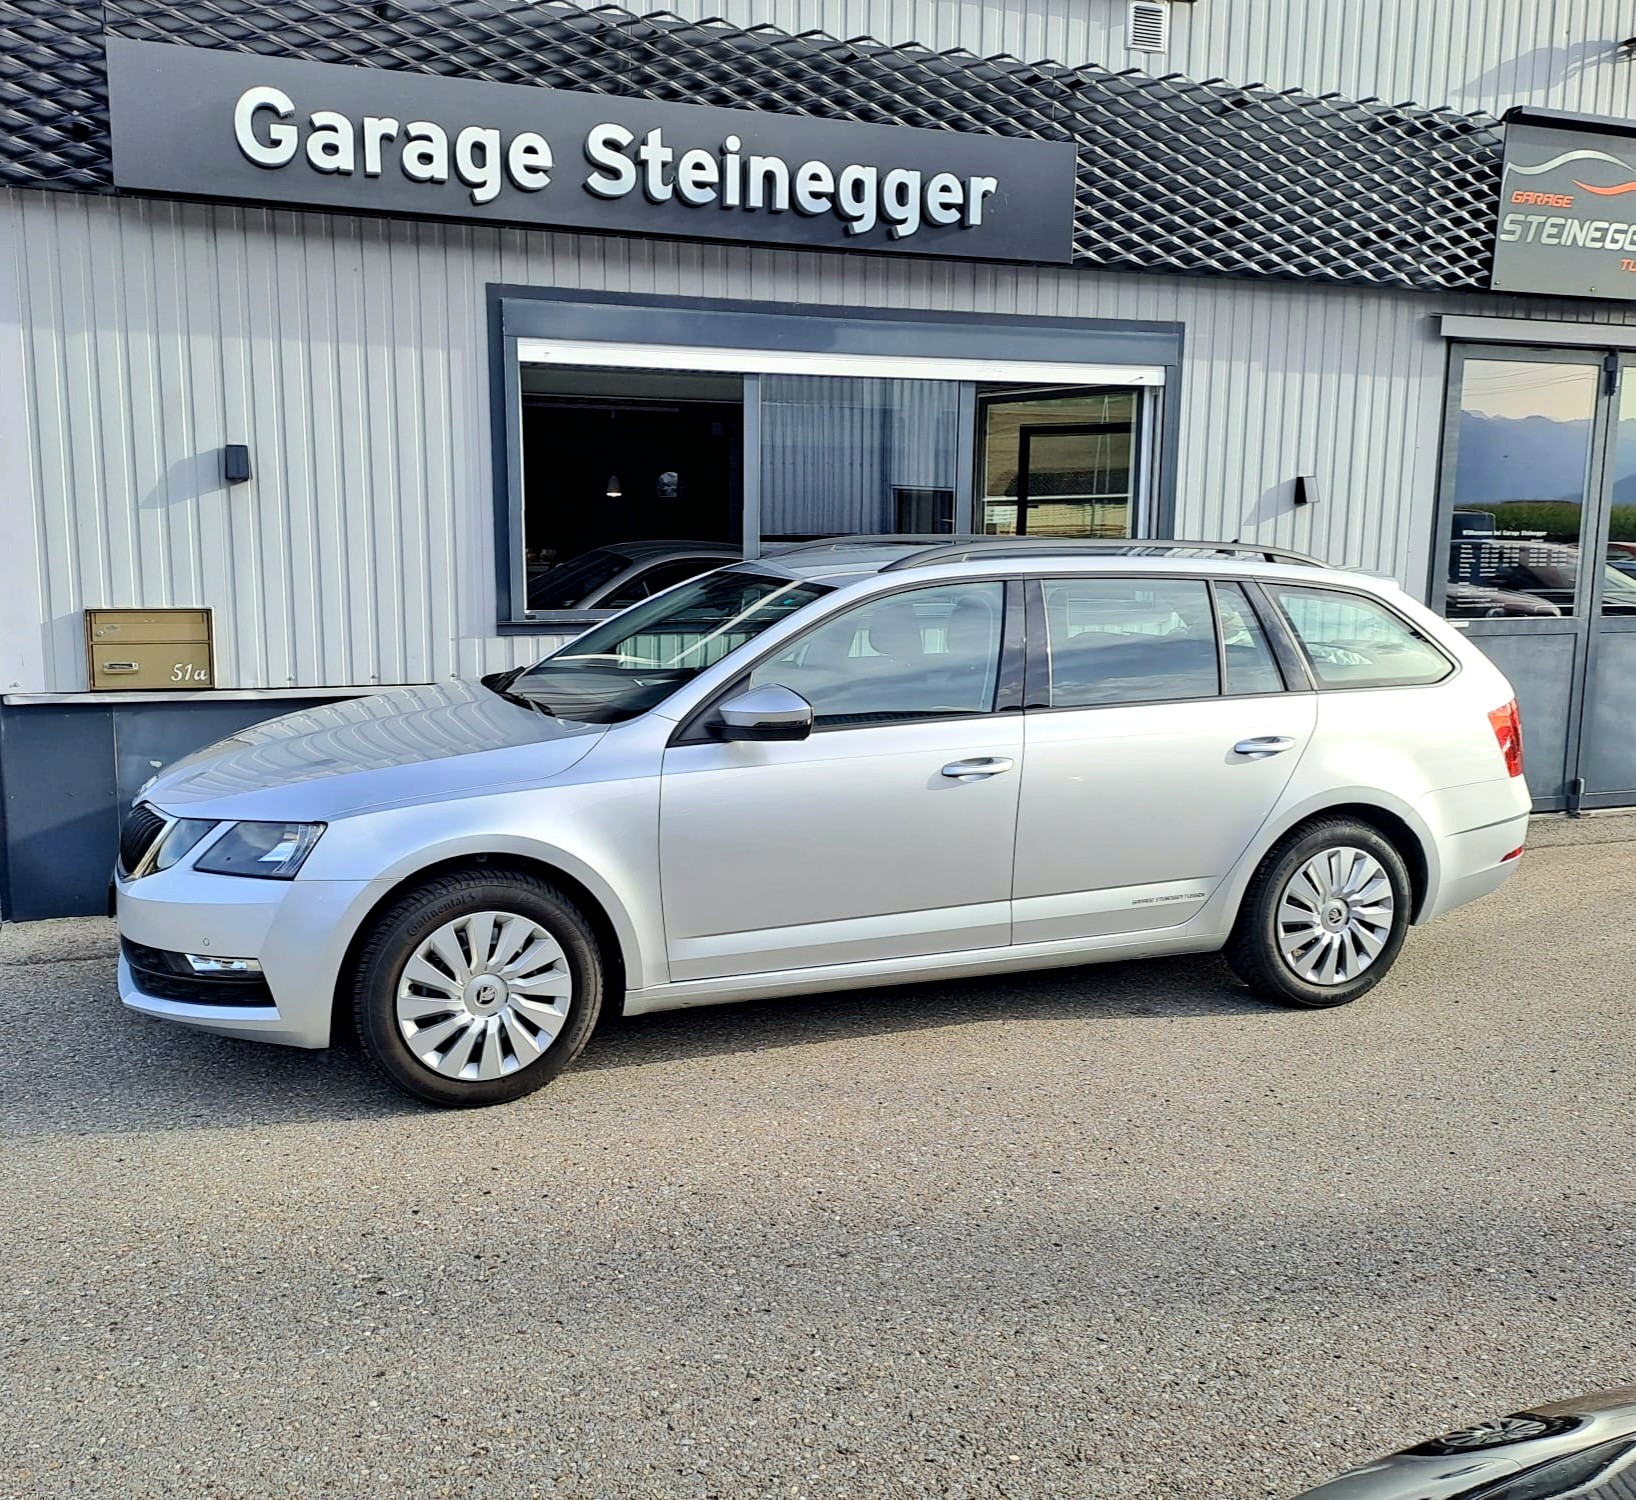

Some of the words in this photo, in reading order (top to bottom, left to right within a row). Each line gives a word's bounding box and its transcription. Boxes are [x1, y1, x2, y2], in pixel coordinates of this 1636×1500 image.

[232, 84, 556, 203] Garage
[583, 122, 999, 239] Steinegger
[1510, 190, 1575, 208] GARAGE
[170, 663, 209, 682] 51a
[408, 894, 466, 936] Continental
